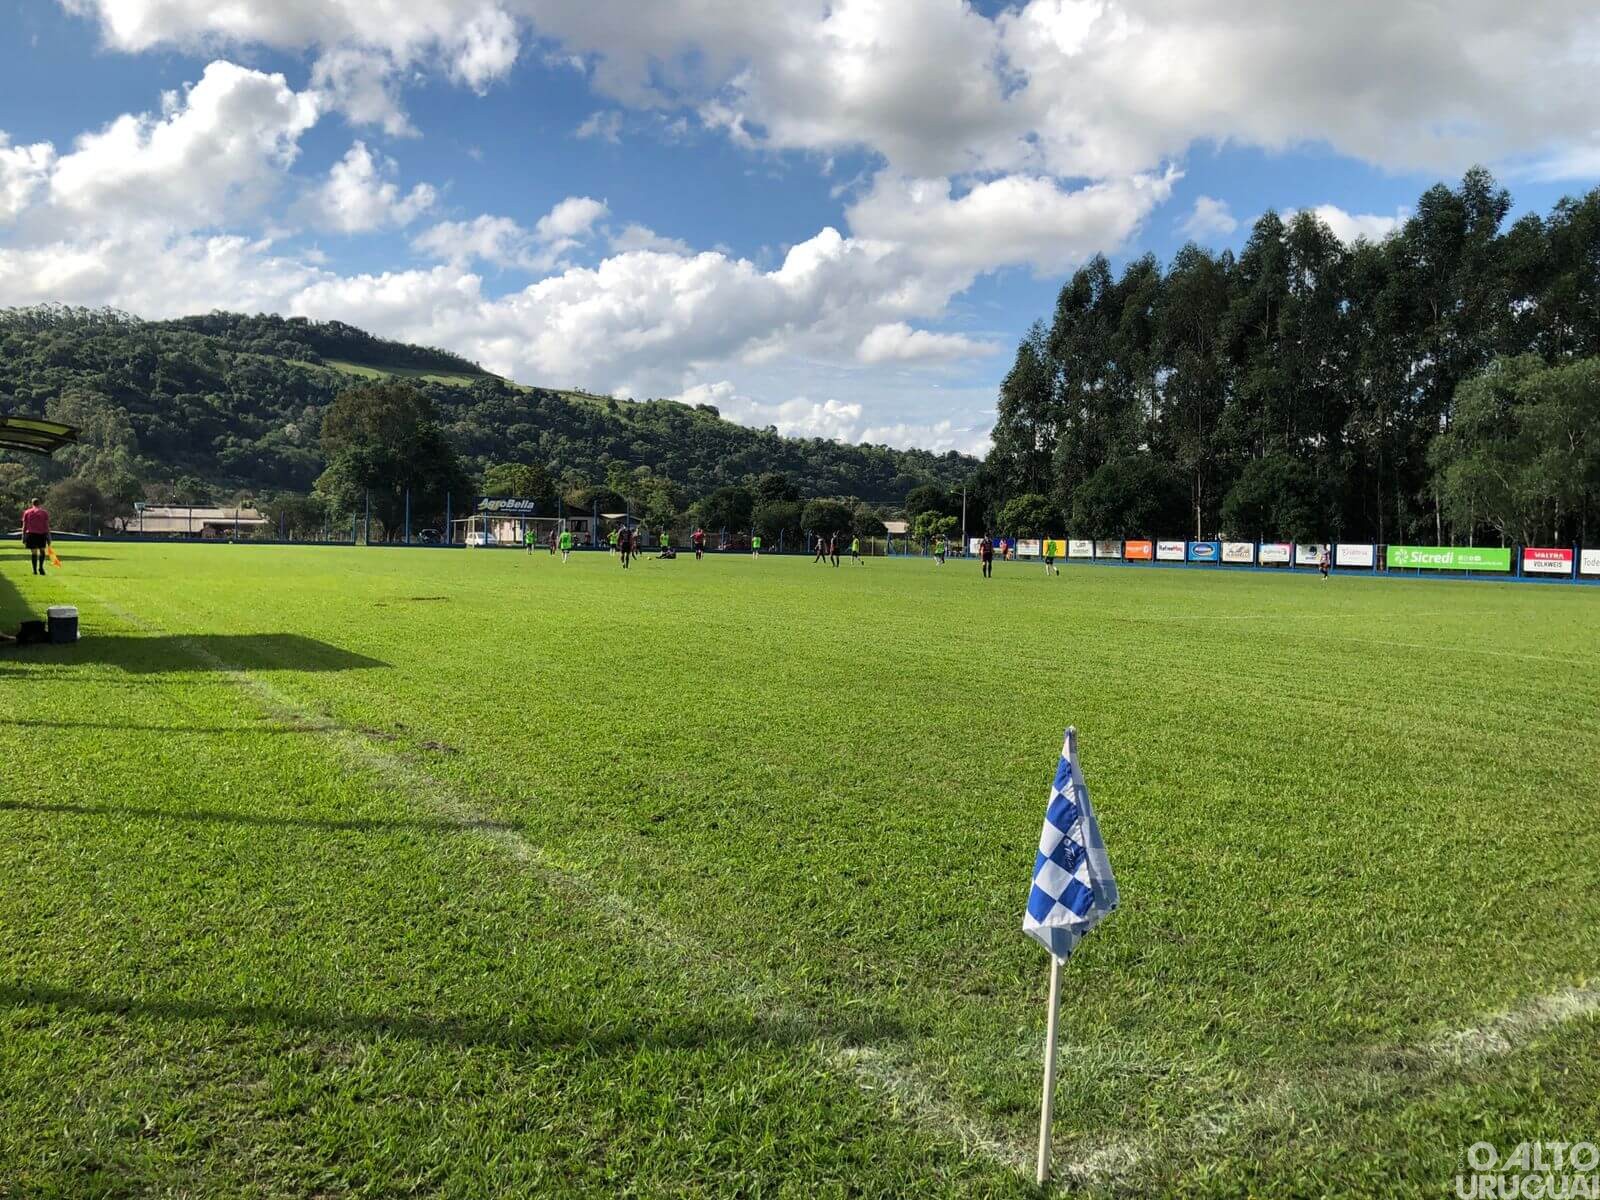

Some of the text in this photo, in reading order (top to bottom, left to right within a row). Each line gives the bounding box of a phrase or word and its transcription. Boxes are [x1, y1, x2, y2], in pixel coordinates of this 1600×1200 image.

[478, 498, 535, 511] AgroBella
[1410, 551, 1454, 564] Sicredi
[1533, 560, 1563, 568] VOLKWEIS
